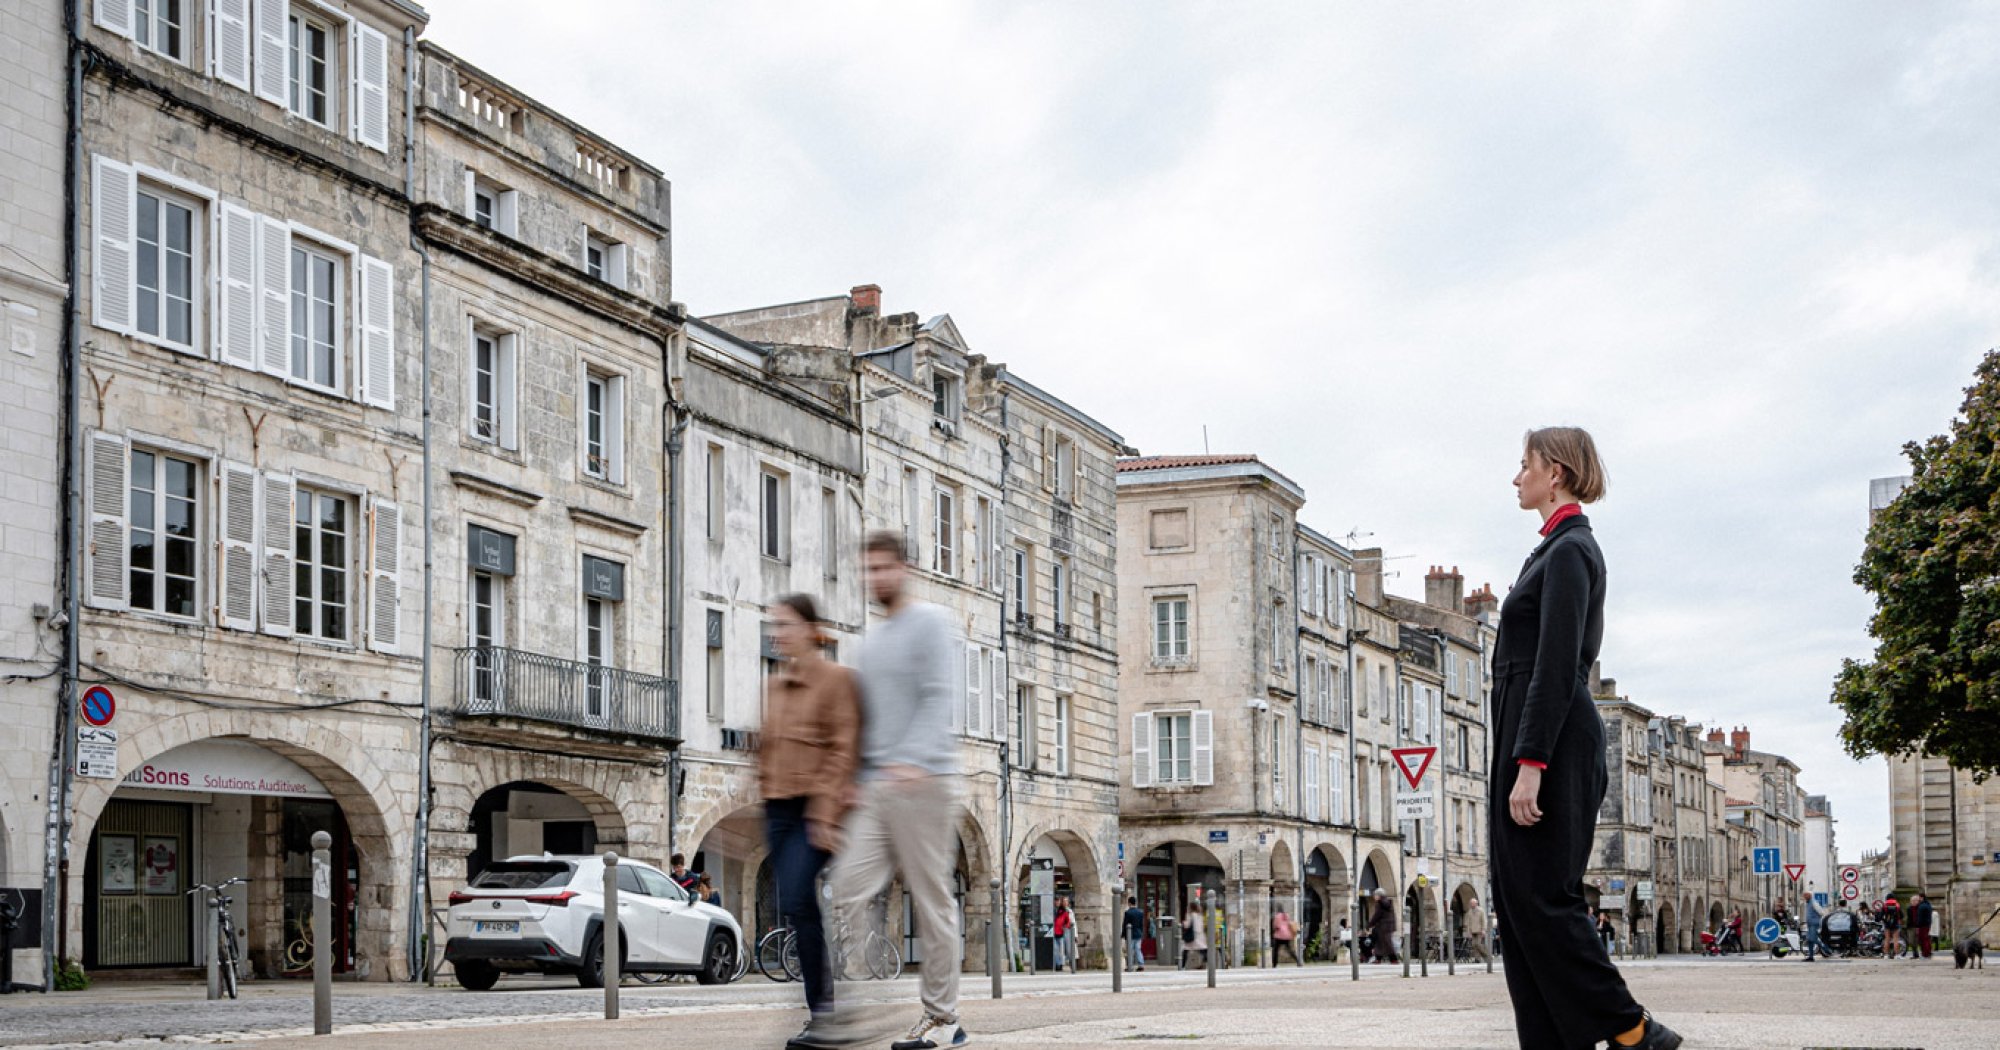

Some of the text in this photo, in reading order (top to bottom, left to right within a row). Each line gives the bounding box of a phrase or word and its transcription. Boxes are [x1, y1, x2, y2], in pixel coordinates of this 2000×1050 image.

[204, 774, 256, 791] Solutions
[258, 778, 307, 793] Auditives
[1396, 797, 1432, 805] PRIORITE
